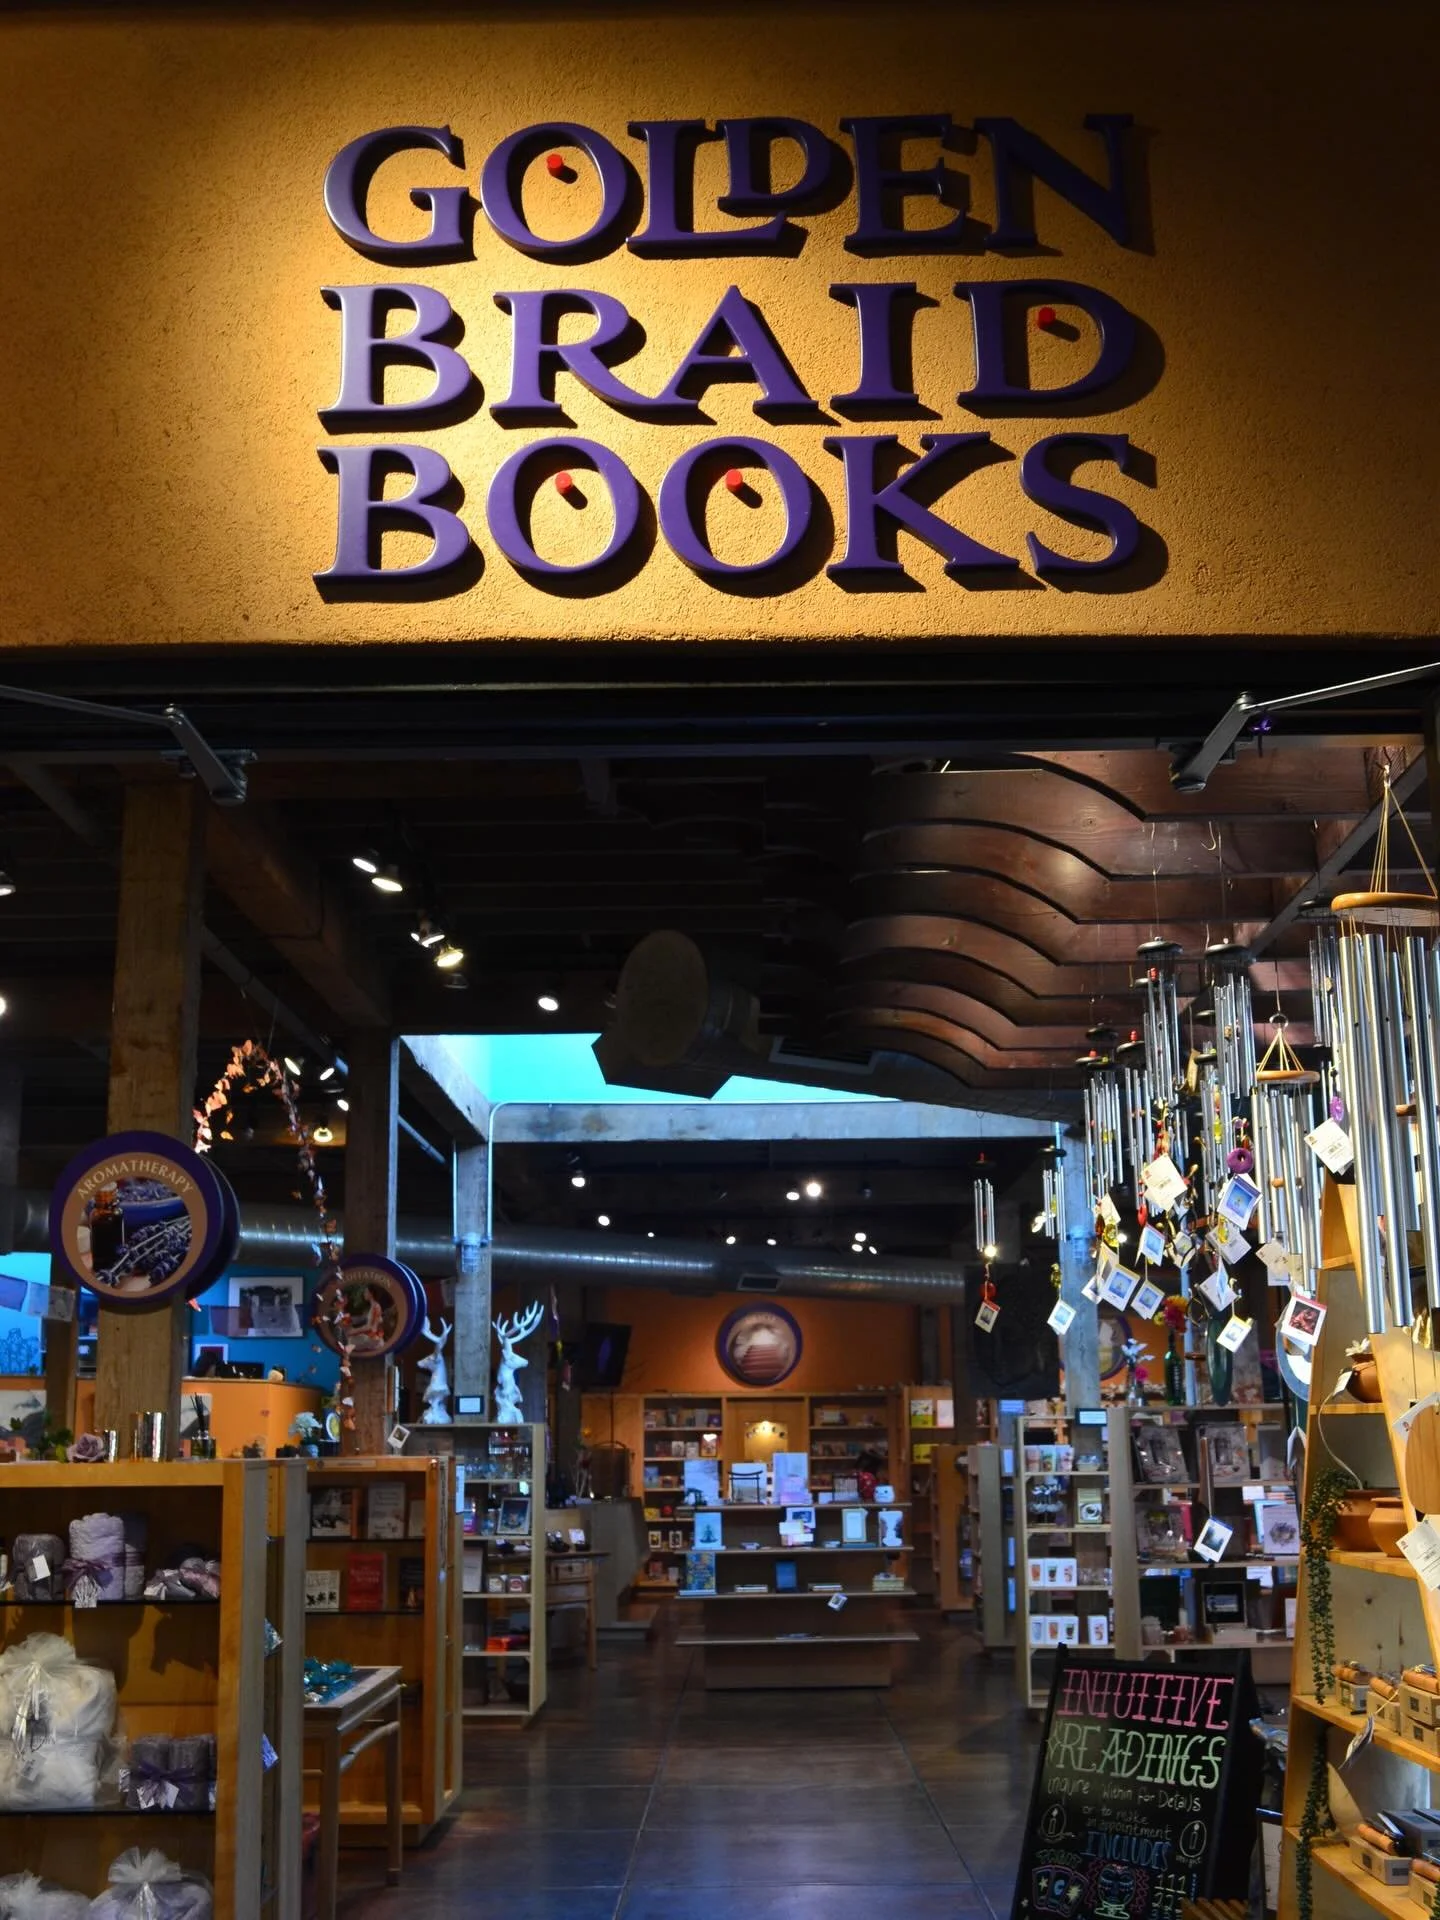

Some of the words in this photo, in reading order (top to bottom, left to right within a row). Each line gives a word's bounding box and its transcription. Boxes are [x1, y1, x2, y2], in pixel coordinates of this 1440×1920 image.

[322, 114, 1136, 255] GOLDEN
[317, 279, 1137, 419] BRAID
[313, 431, 1141, 583] BOOKS
[77, 1159, 194, 1199] AROMATHERAPY
[337, 1271, 392, 1289] DITATION
[1056, 1668, 1236, 1731] INTUITIVE
[1055, 1721, 1228, 1789] READINGS
